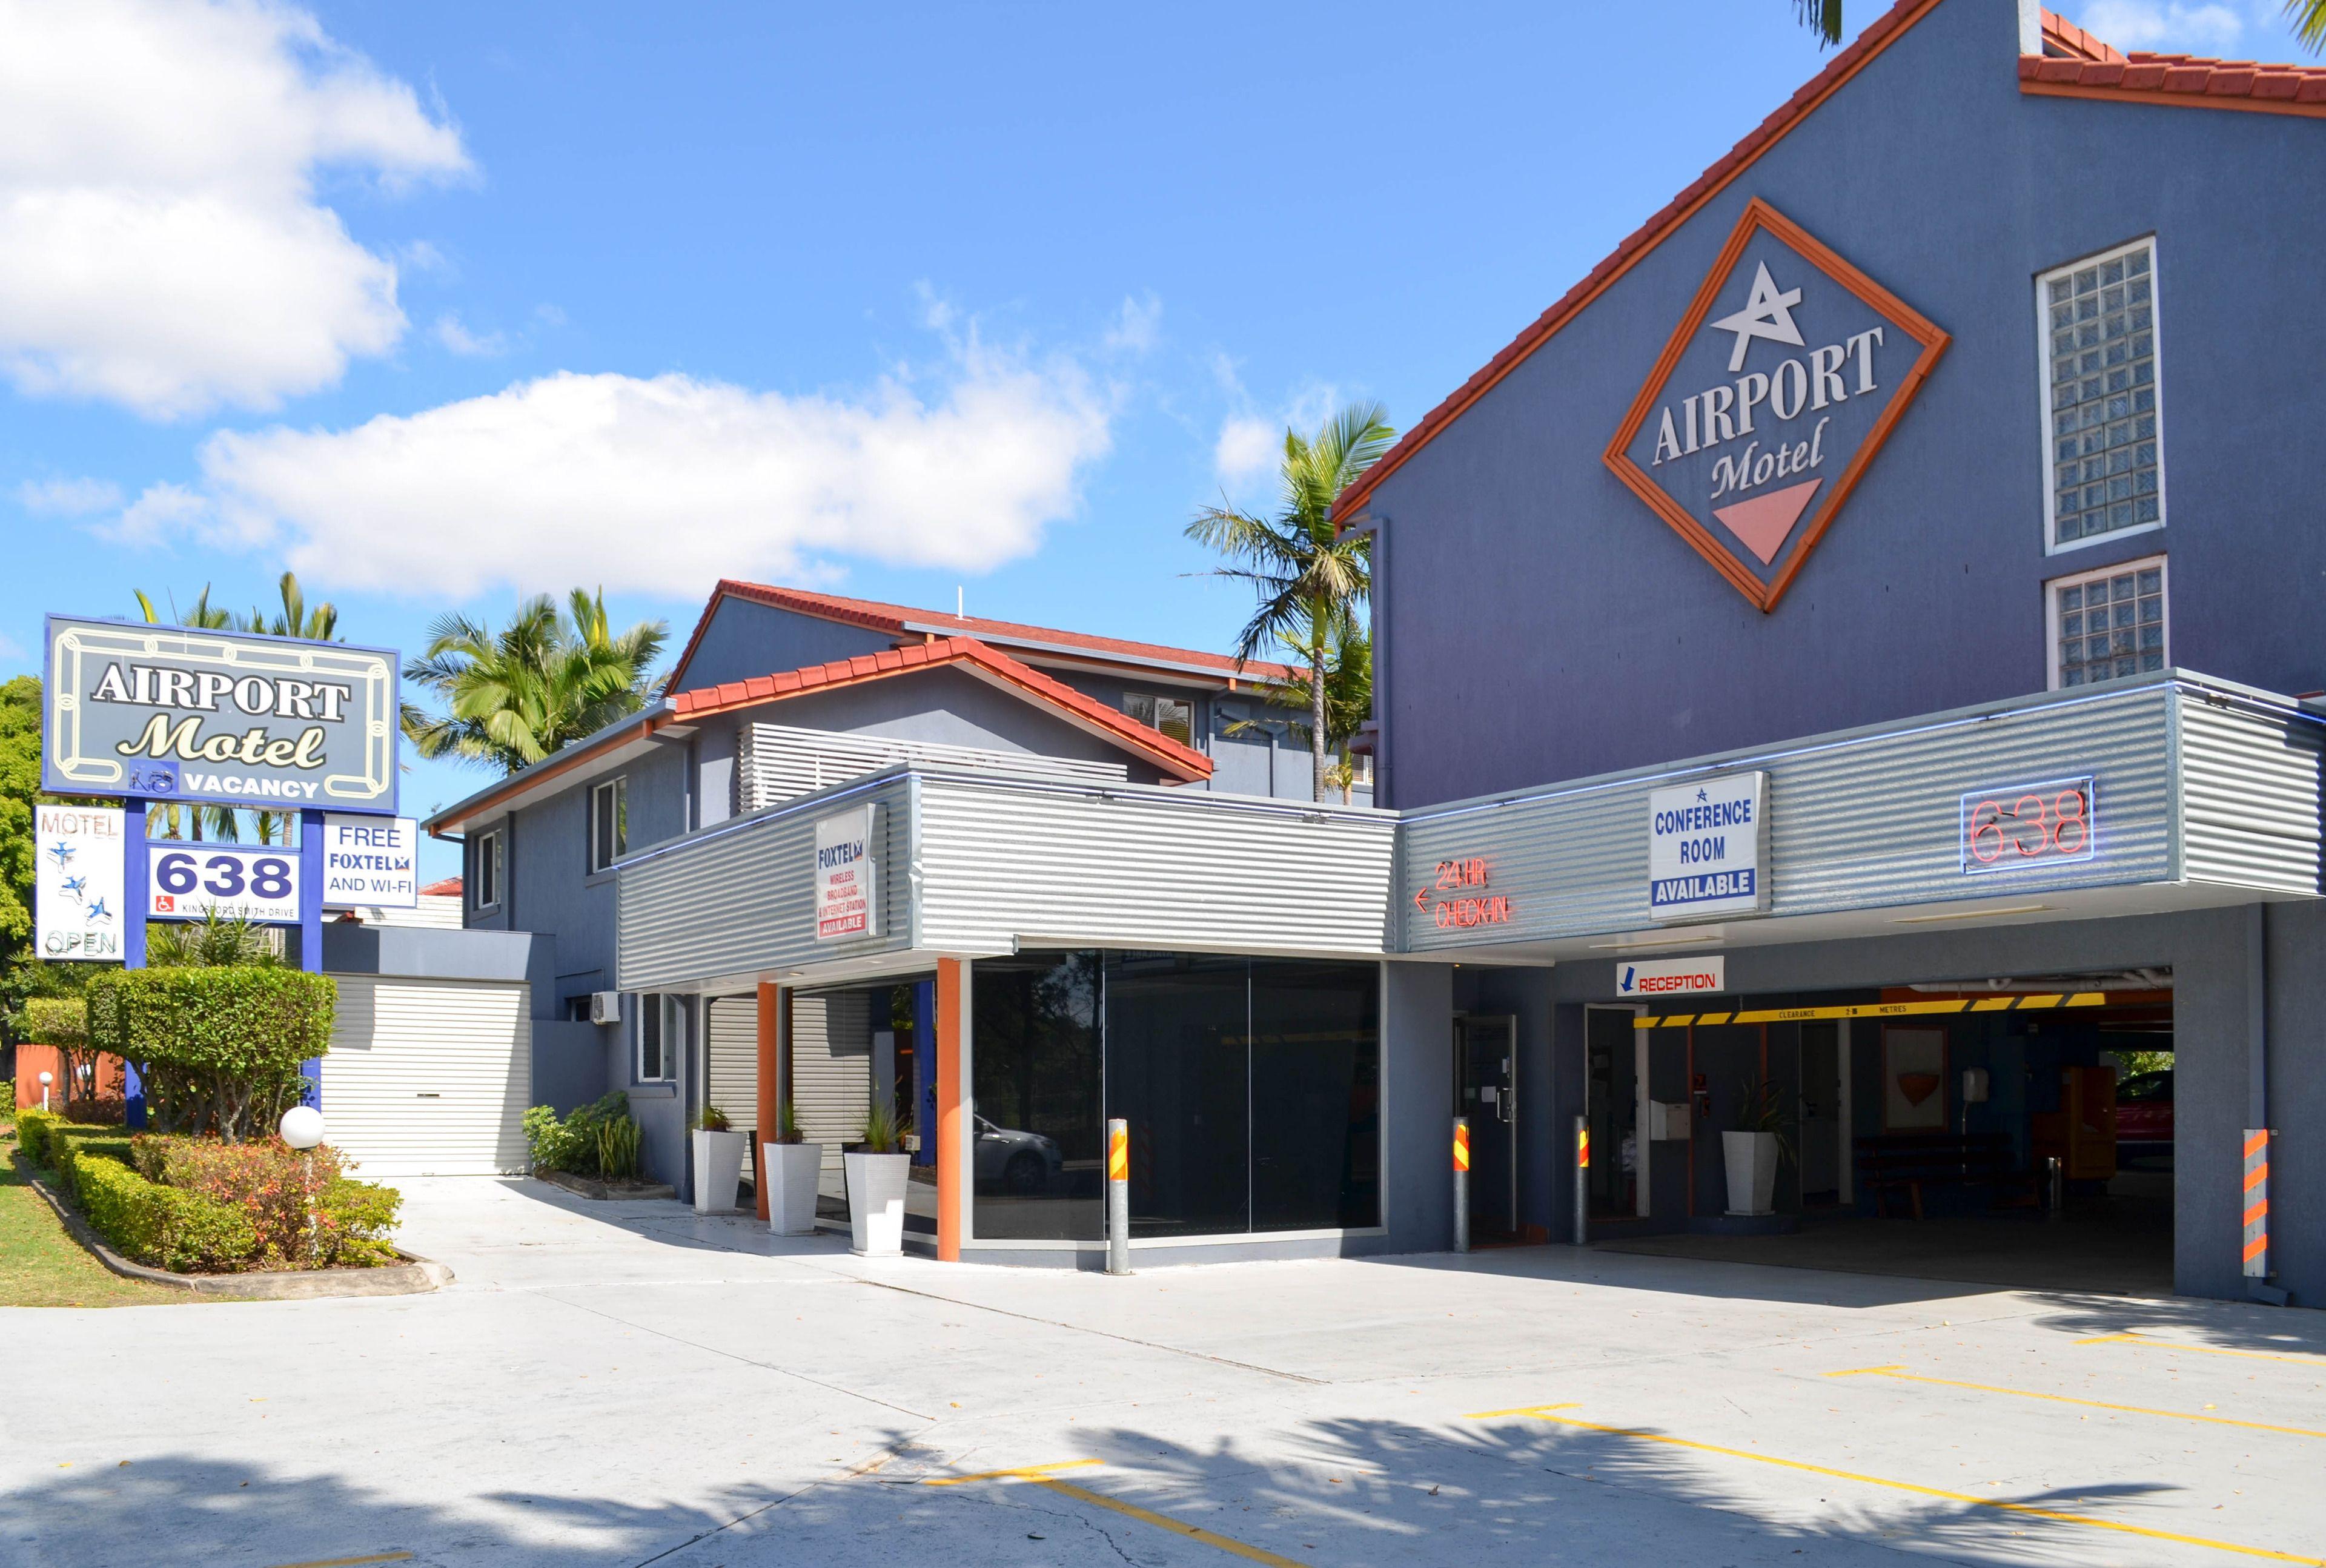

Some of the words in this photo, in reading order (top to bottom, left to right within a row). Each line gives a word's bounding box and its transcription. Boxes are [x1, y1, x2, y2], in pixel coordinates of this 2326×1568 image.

[1652, 327, 1883, 465] AIRPORT
[1711, 417, 1829, 498] Motel
[91, 663, 351, 723] AIRPORT
[117, 713, 326, 769] Motel
[184, 773, 319, 799] VACANCY
[42, 813, 118, 836] MOTEL
[1655, 799, 1751, 835] CONFERENCE
[1970, 789, 2086, 862] 638
[340, 827, 401, 847] FREE
[330, 853, 393, 871] FOXTEL
[819, 842, 854, 869] FOXTEL
[1680, 836, 1725, 864] ROOM
[156, 853, 292, 899] 638
[330, 878, 365, 891] AND
[371, 879, 411, 893] WI-FI
[830, 870, 854, 885] WIRELESS
[1435, 861, 1463, 890] 24
[1465, 857, 1486, 887] HR
[827, 885, 858, 901] BROADBAND
[1655, 872, 1750, 902] AVAILABLE
[269, 908, 294, 917] DRIVE
[823, 903, 846, 917] INTERNET
[846, 899, 866, 913] STATION
[823, 916, 862, 934] AVAILABLE
[46, 930, 116, 954] OPEN
[1639, 973, 1715, 992] RECEPTION
[1779, 1010, 1815, 1019] CLEARANCE
